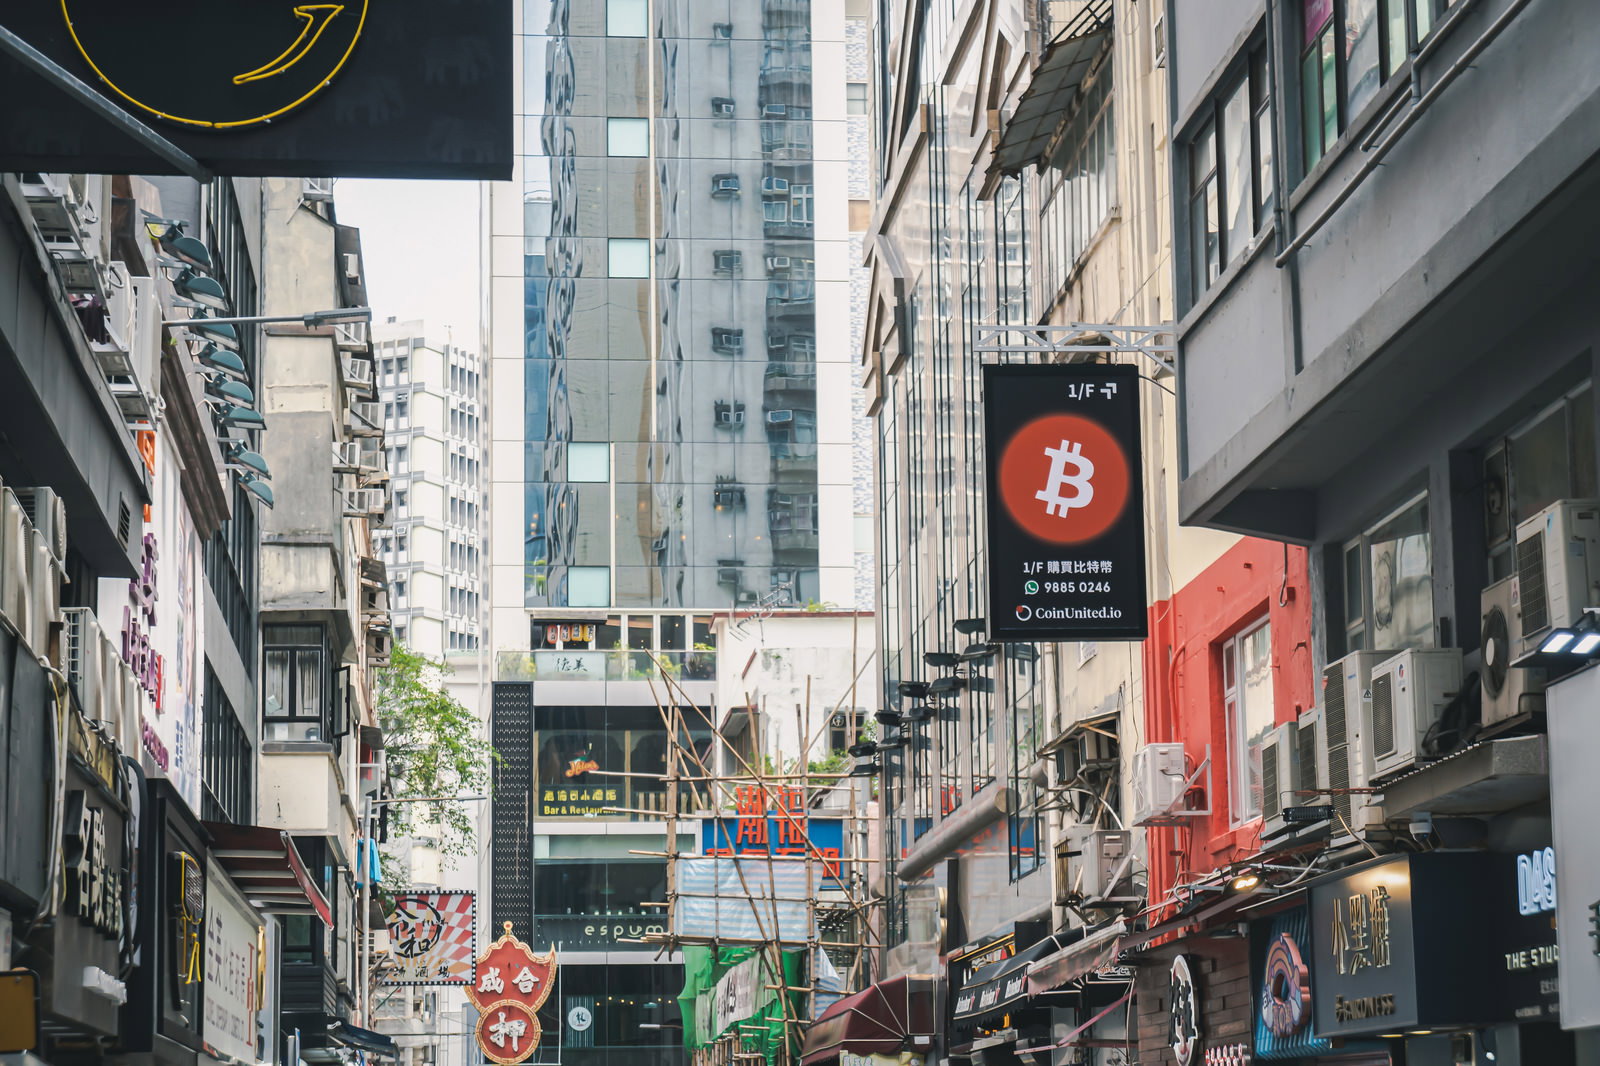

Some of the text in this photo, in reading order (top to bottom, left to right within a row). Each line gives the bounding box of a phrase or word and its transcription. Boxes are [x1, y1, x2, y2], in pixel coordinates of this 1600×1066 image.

[1068, 383, 1095, 400] 1/F
[1023, 560, 1113, 575] 1/F 購買比特幣
[1044, 582, 1111, 593] 9885 0246
[1036, 607, 1122, 620] CoinUnited.io
[544, 805, 559, 815] Bar
[1505, 951, 1527, 970] THE
[489, 1012, 528, 1051] 押
